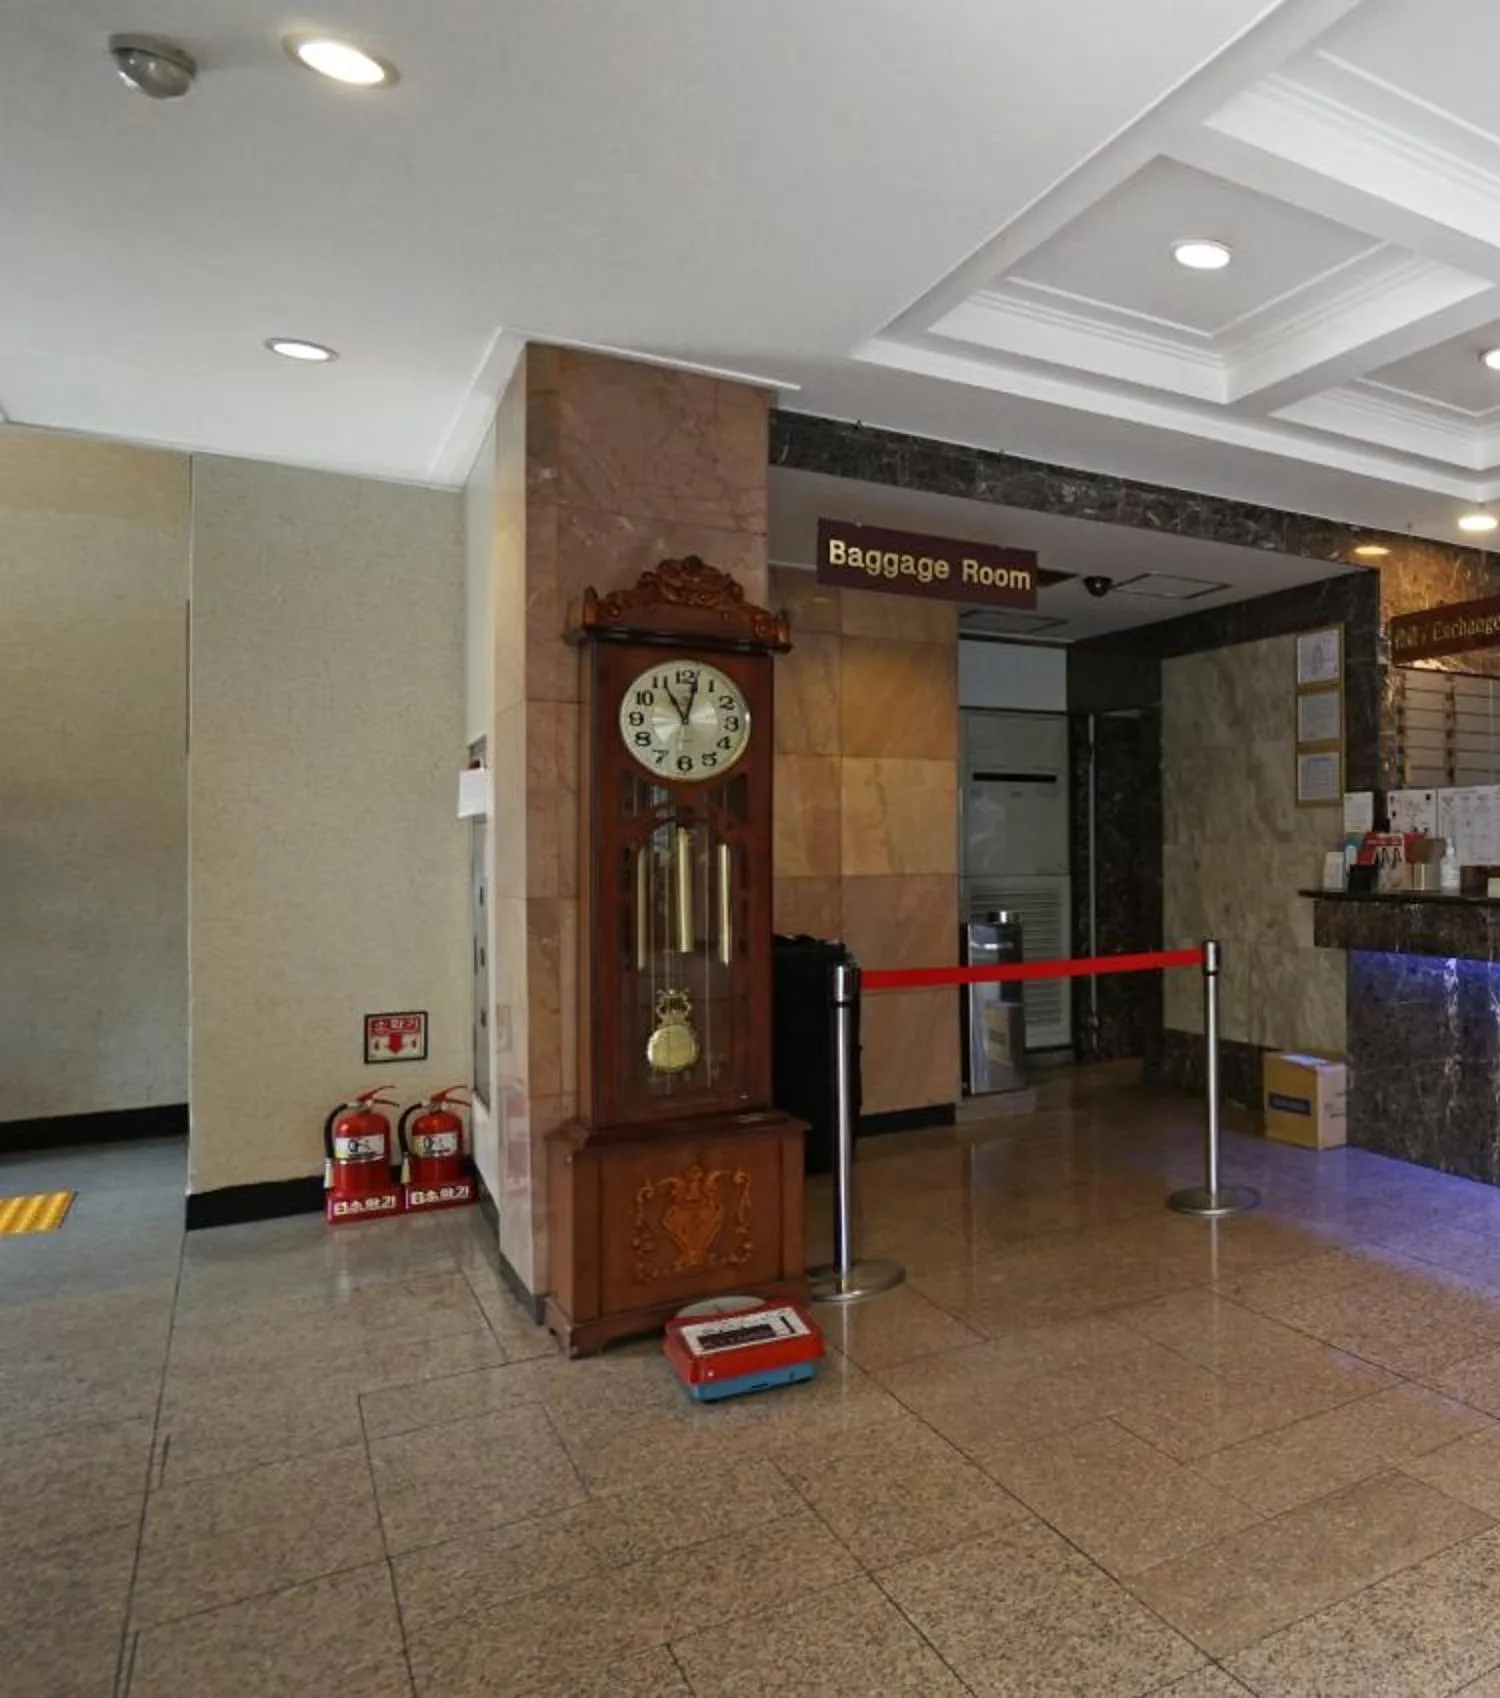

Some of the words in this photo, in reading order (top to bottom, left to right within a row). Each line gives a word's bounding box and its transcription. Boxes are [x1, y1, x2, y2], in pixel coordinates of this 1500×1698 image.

[828, 539, 950, 582] Baggage
[961, 558, 1032, 592] Room
[675, 669, 696, 685] 12
[636, 690, 654, 706] 10
[719, 695, 735, 710] 2
[629, 711, 644, 726] 9
[724, 716, 739, 732] 3
[635, 731, 651, 747] 8
[716, 736, 732, 750] 4
[652, 749, 669, 763] 7
[677, 755, 693, 772] 6
[702, 751, 717, 767] 5
[374, 1017, 419, 1034] 소화기
